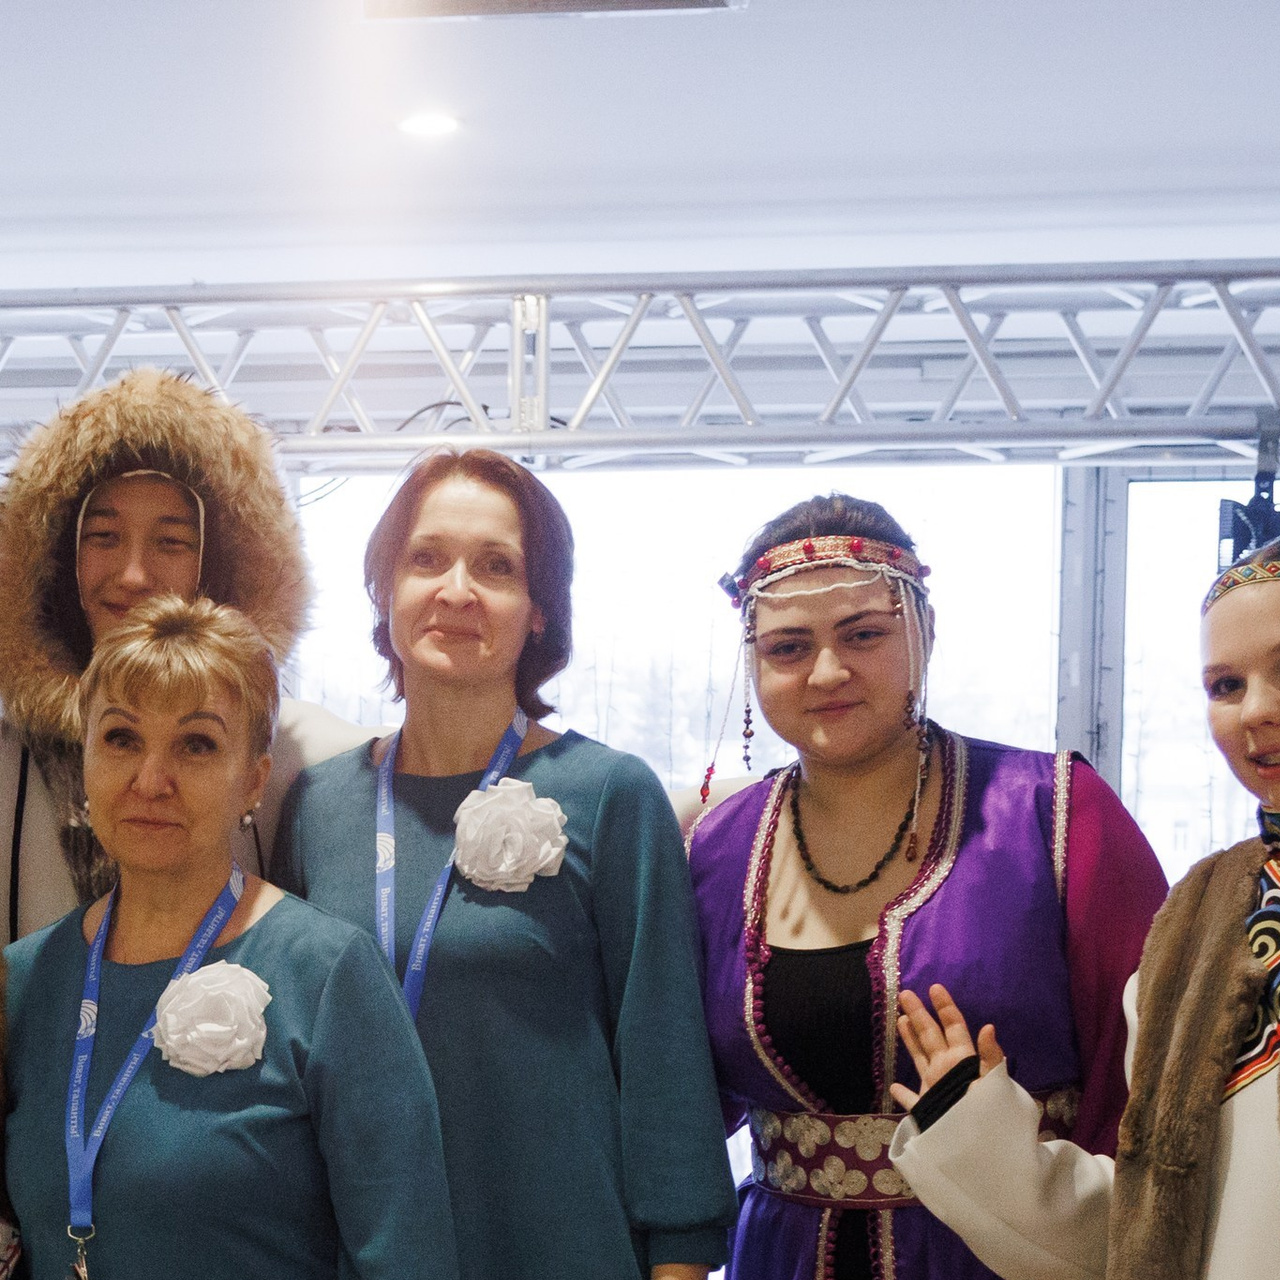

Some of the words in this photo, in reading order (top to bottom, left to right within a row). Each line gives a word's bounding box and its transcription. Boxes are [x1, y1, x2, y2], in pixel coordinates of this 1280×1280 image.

[381, 887, 391, 920] Виват,
[195, 906, 226, 951] таланты!
[411, 935, 428, 971] Виват,
[423, 884, 444, 933] таланты!
[74, 1055, 88, 1088] Виват,
[93, 1101, 115, 1137] Виват,
[110, 1053, 140, 1101] таланты!
[70, 1088, 80, 1138] таланты!
